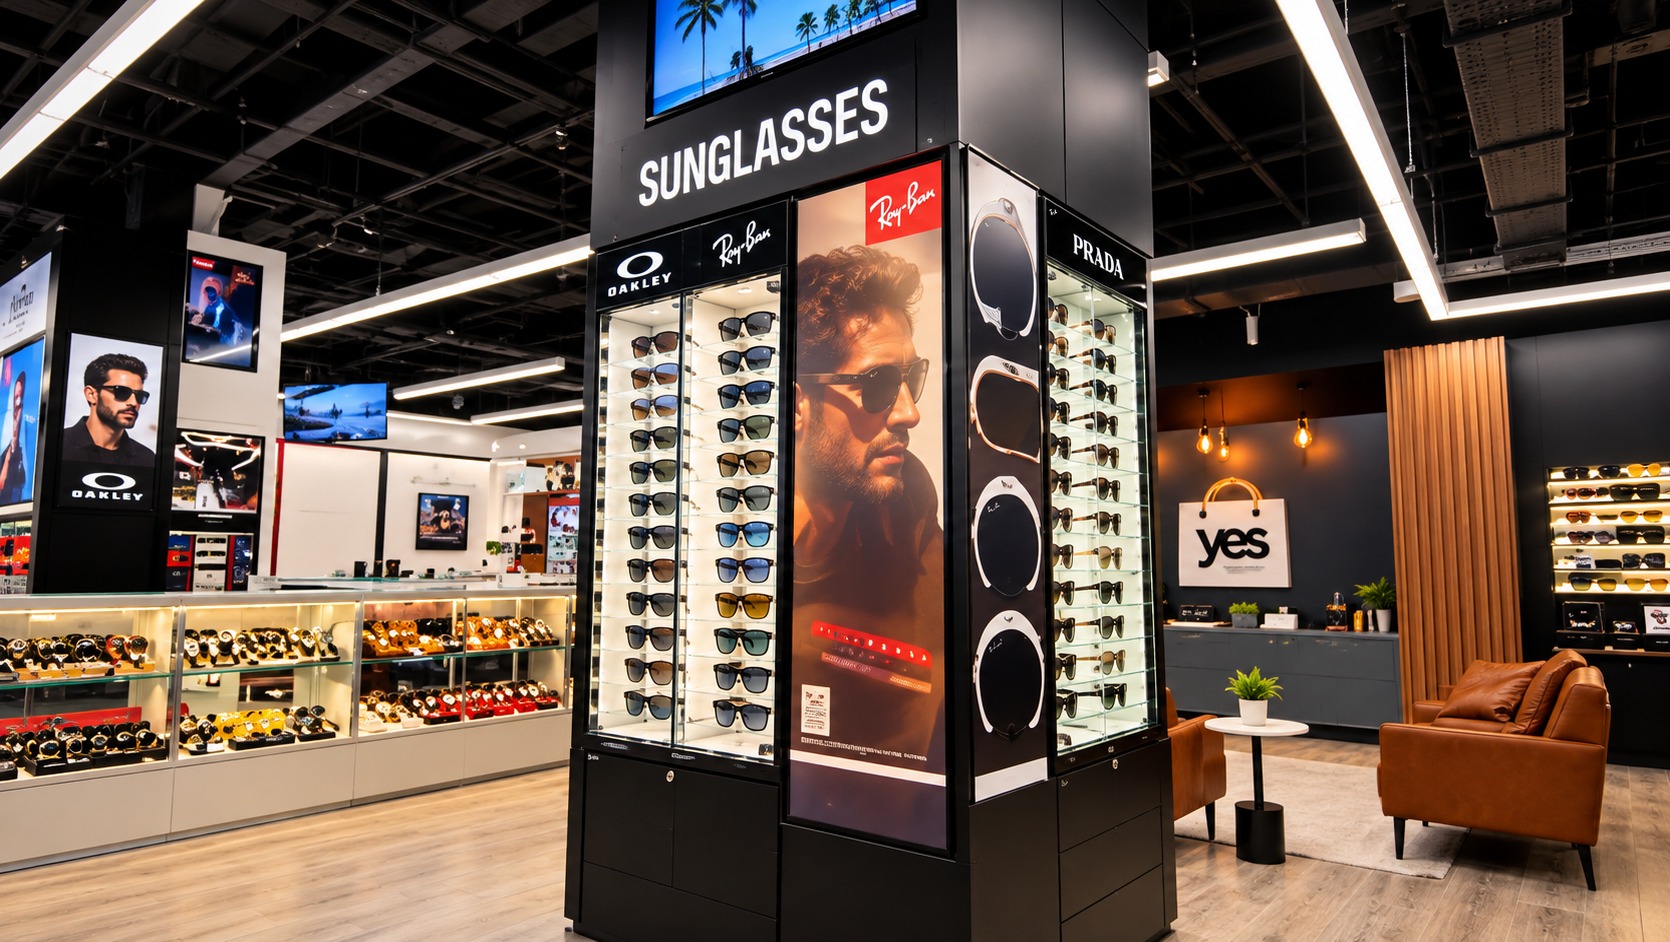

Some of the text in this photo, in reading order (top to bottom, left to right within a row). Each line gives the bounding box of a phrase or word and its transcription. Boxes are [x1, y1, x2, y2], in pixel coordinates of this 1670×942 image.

[638, 78, 889, 207] SUNGLASSES
[869, 180, 936, 231] Ray-Ban
[712, 220, 771, 268] Ray-Ban
[1072, 233, 1125, 281] PRADA
[607, 272, 672, 297] OAKLEY
[71, 489, 144, 501] OAKLEY
[1195, 527, 1271, 569] yes
